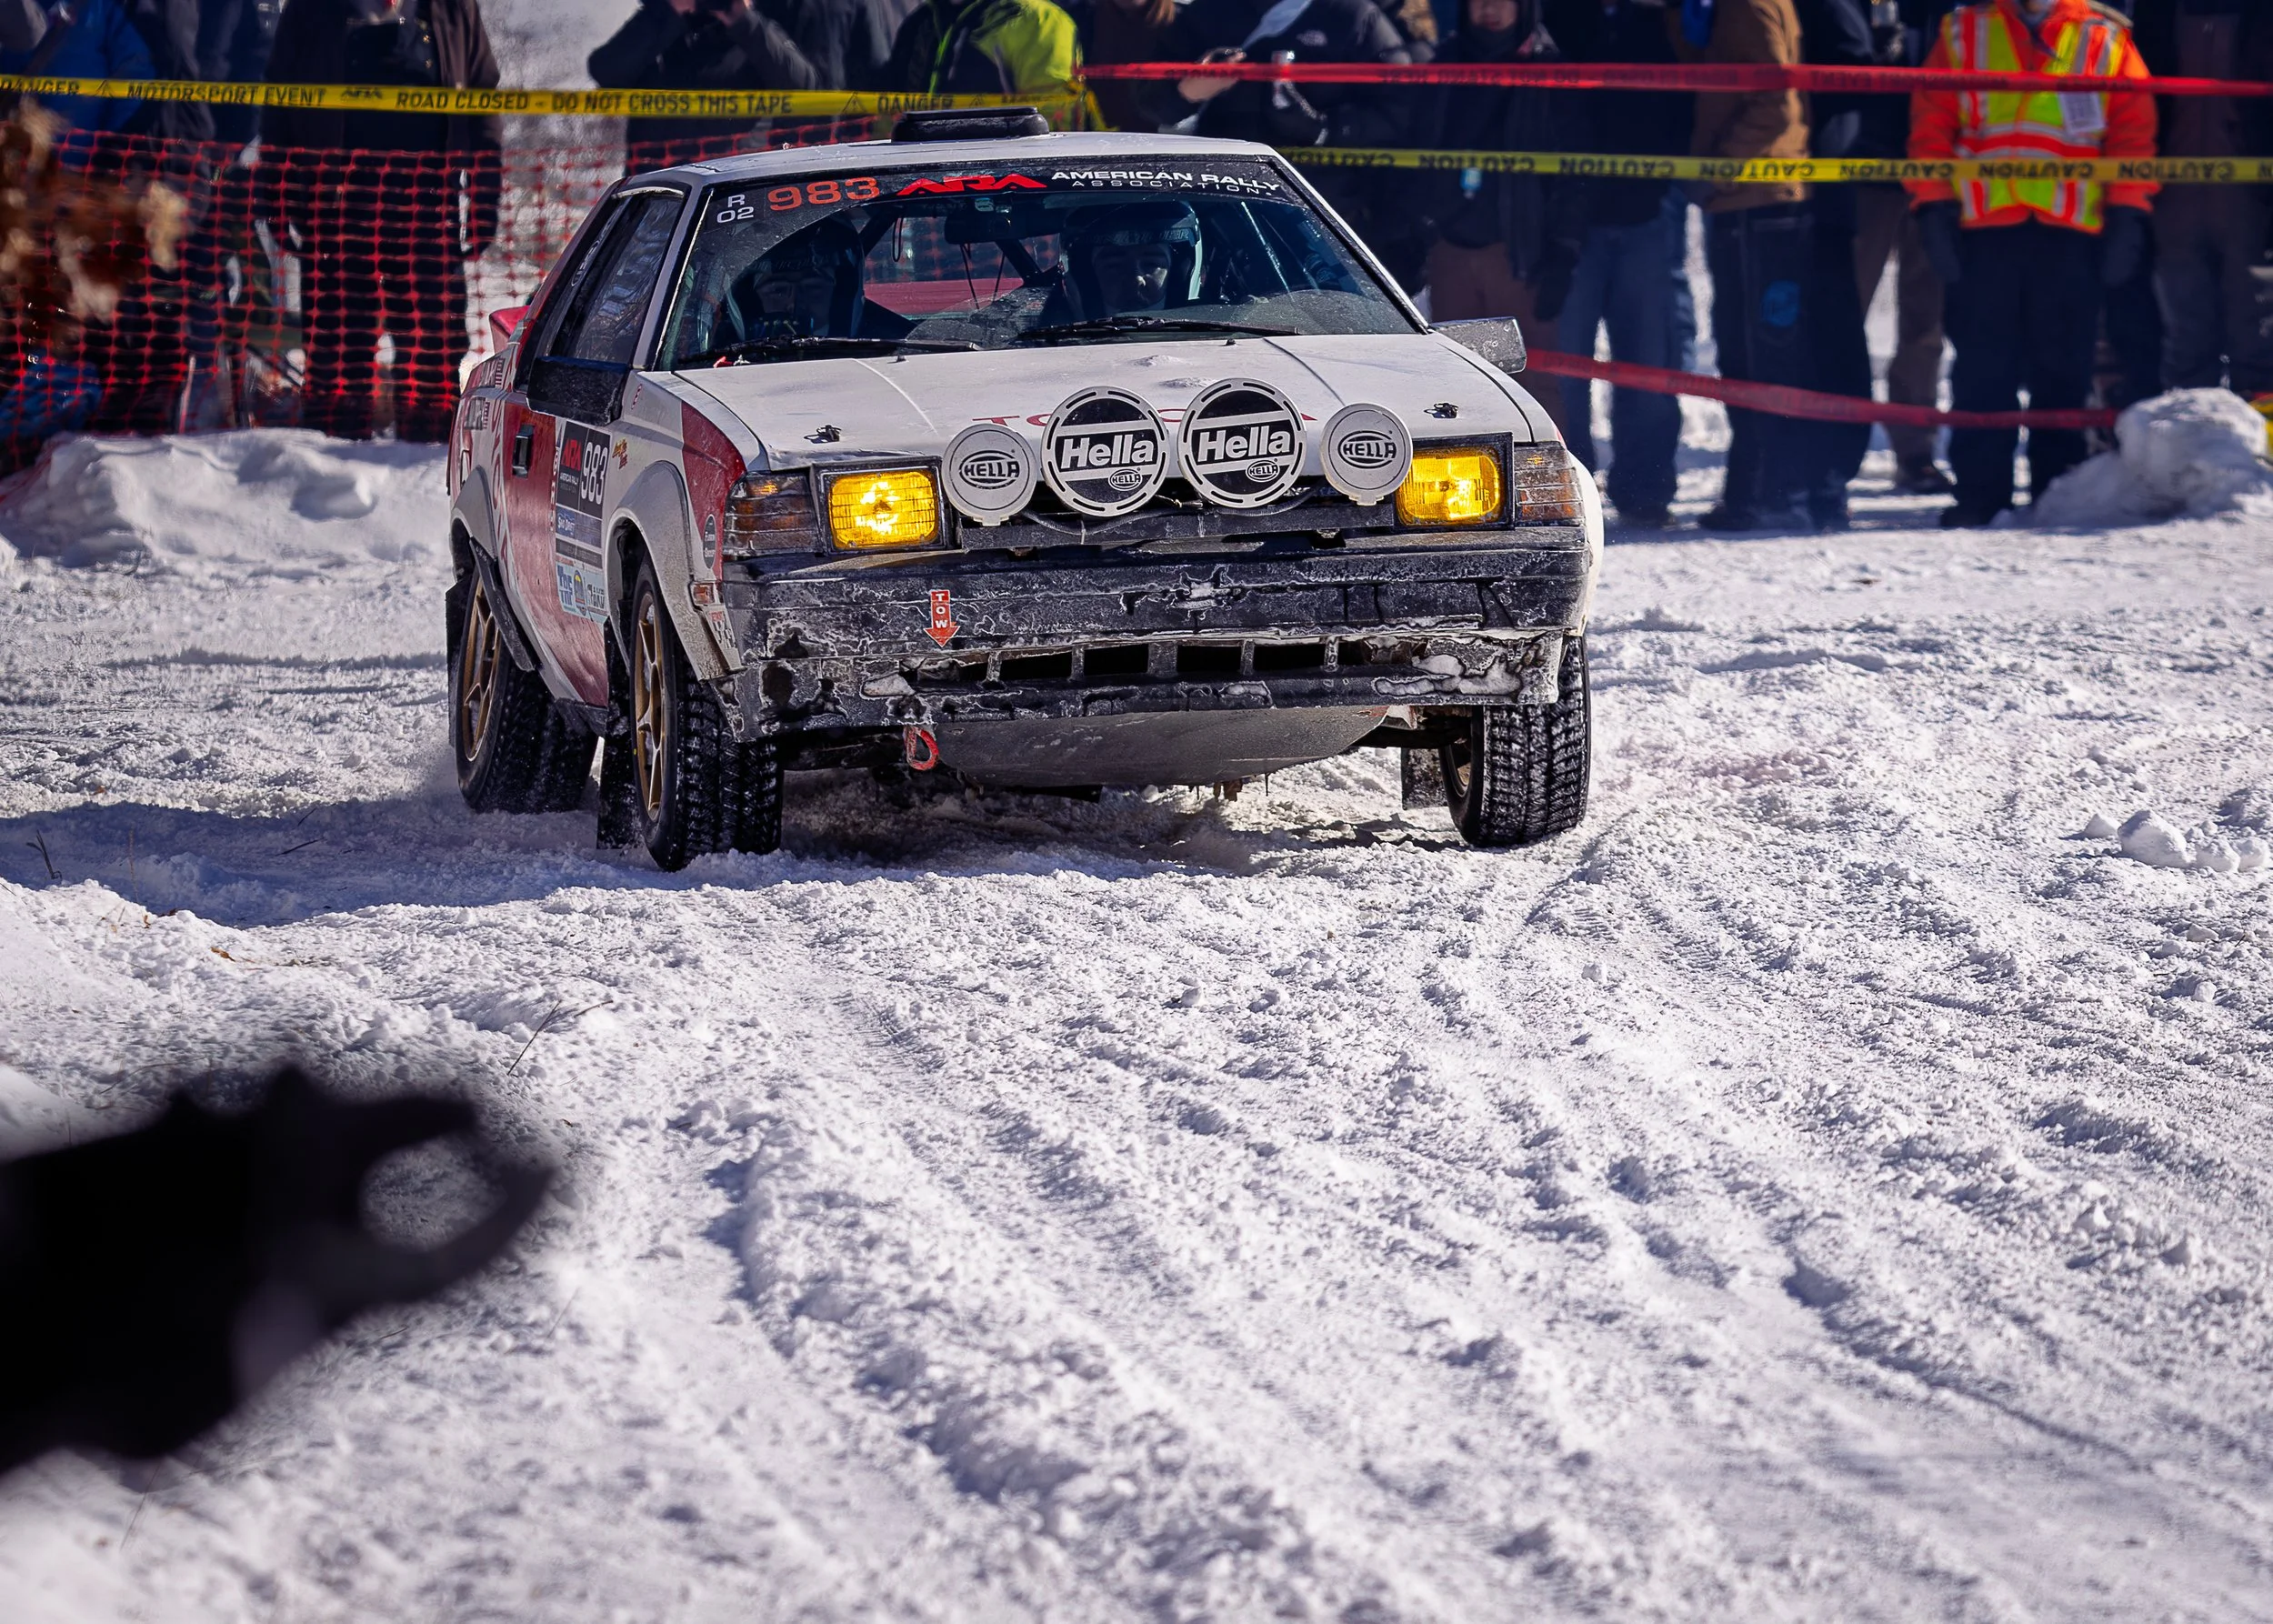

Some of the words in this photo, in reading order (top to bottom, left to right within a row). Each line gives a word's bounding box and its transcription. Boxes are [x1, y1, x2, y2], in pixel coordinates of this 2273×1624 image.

[127, 81, 259, 105] MOTORSPORT
[264, 86, 326, 106] EVENT
[396, 92, 448, 109] ROAD
[456, 93, 530, 110] CLOSED
[552, 94, 577, 111] DO
[585, 93, 622, 111] NOT
[628, 95, 689, 112] CROSS
[698, 95, 738, 114] THIS
[746, 95, 793, 114] TAPE
[877, 95, 954, 114] DANGER
[1418, 154, 1536, 172] CAUTION
[1558, 157, 1676, 178] CAUTION
[1699, 161, 1817, 177] CAUTION
[1839, 161, 1954, 178] CAUTION
[1978, 161, 2095, 178] CAUTION
[2118, 160, 2236, 179] CAUTION
[896, 173, 1047, 196] ARA
[1051, 171, 1192, 181] AMERICAN
[1201, 174, 1280, 191] RALLY
[1071, 180, 1260, 195] ASSOCIATION
[727, 194, 746, 207] R
[767, 176, 881, 212] 983
[716, 207, 755, 224] 02
[1060, 434, 1155, 469] Hella
[1197, 425, 1291, 463] Hella
[1343, 442, 1397, 459] HELLA
[581, 441, 608, 505] 983
[964, 460, 1020, 478] HELLA
[1248, 464, 1278, 476] HELLA
[1112, 473, 1141, 484] HELLA
[935, 593, 948, 629] TOW
